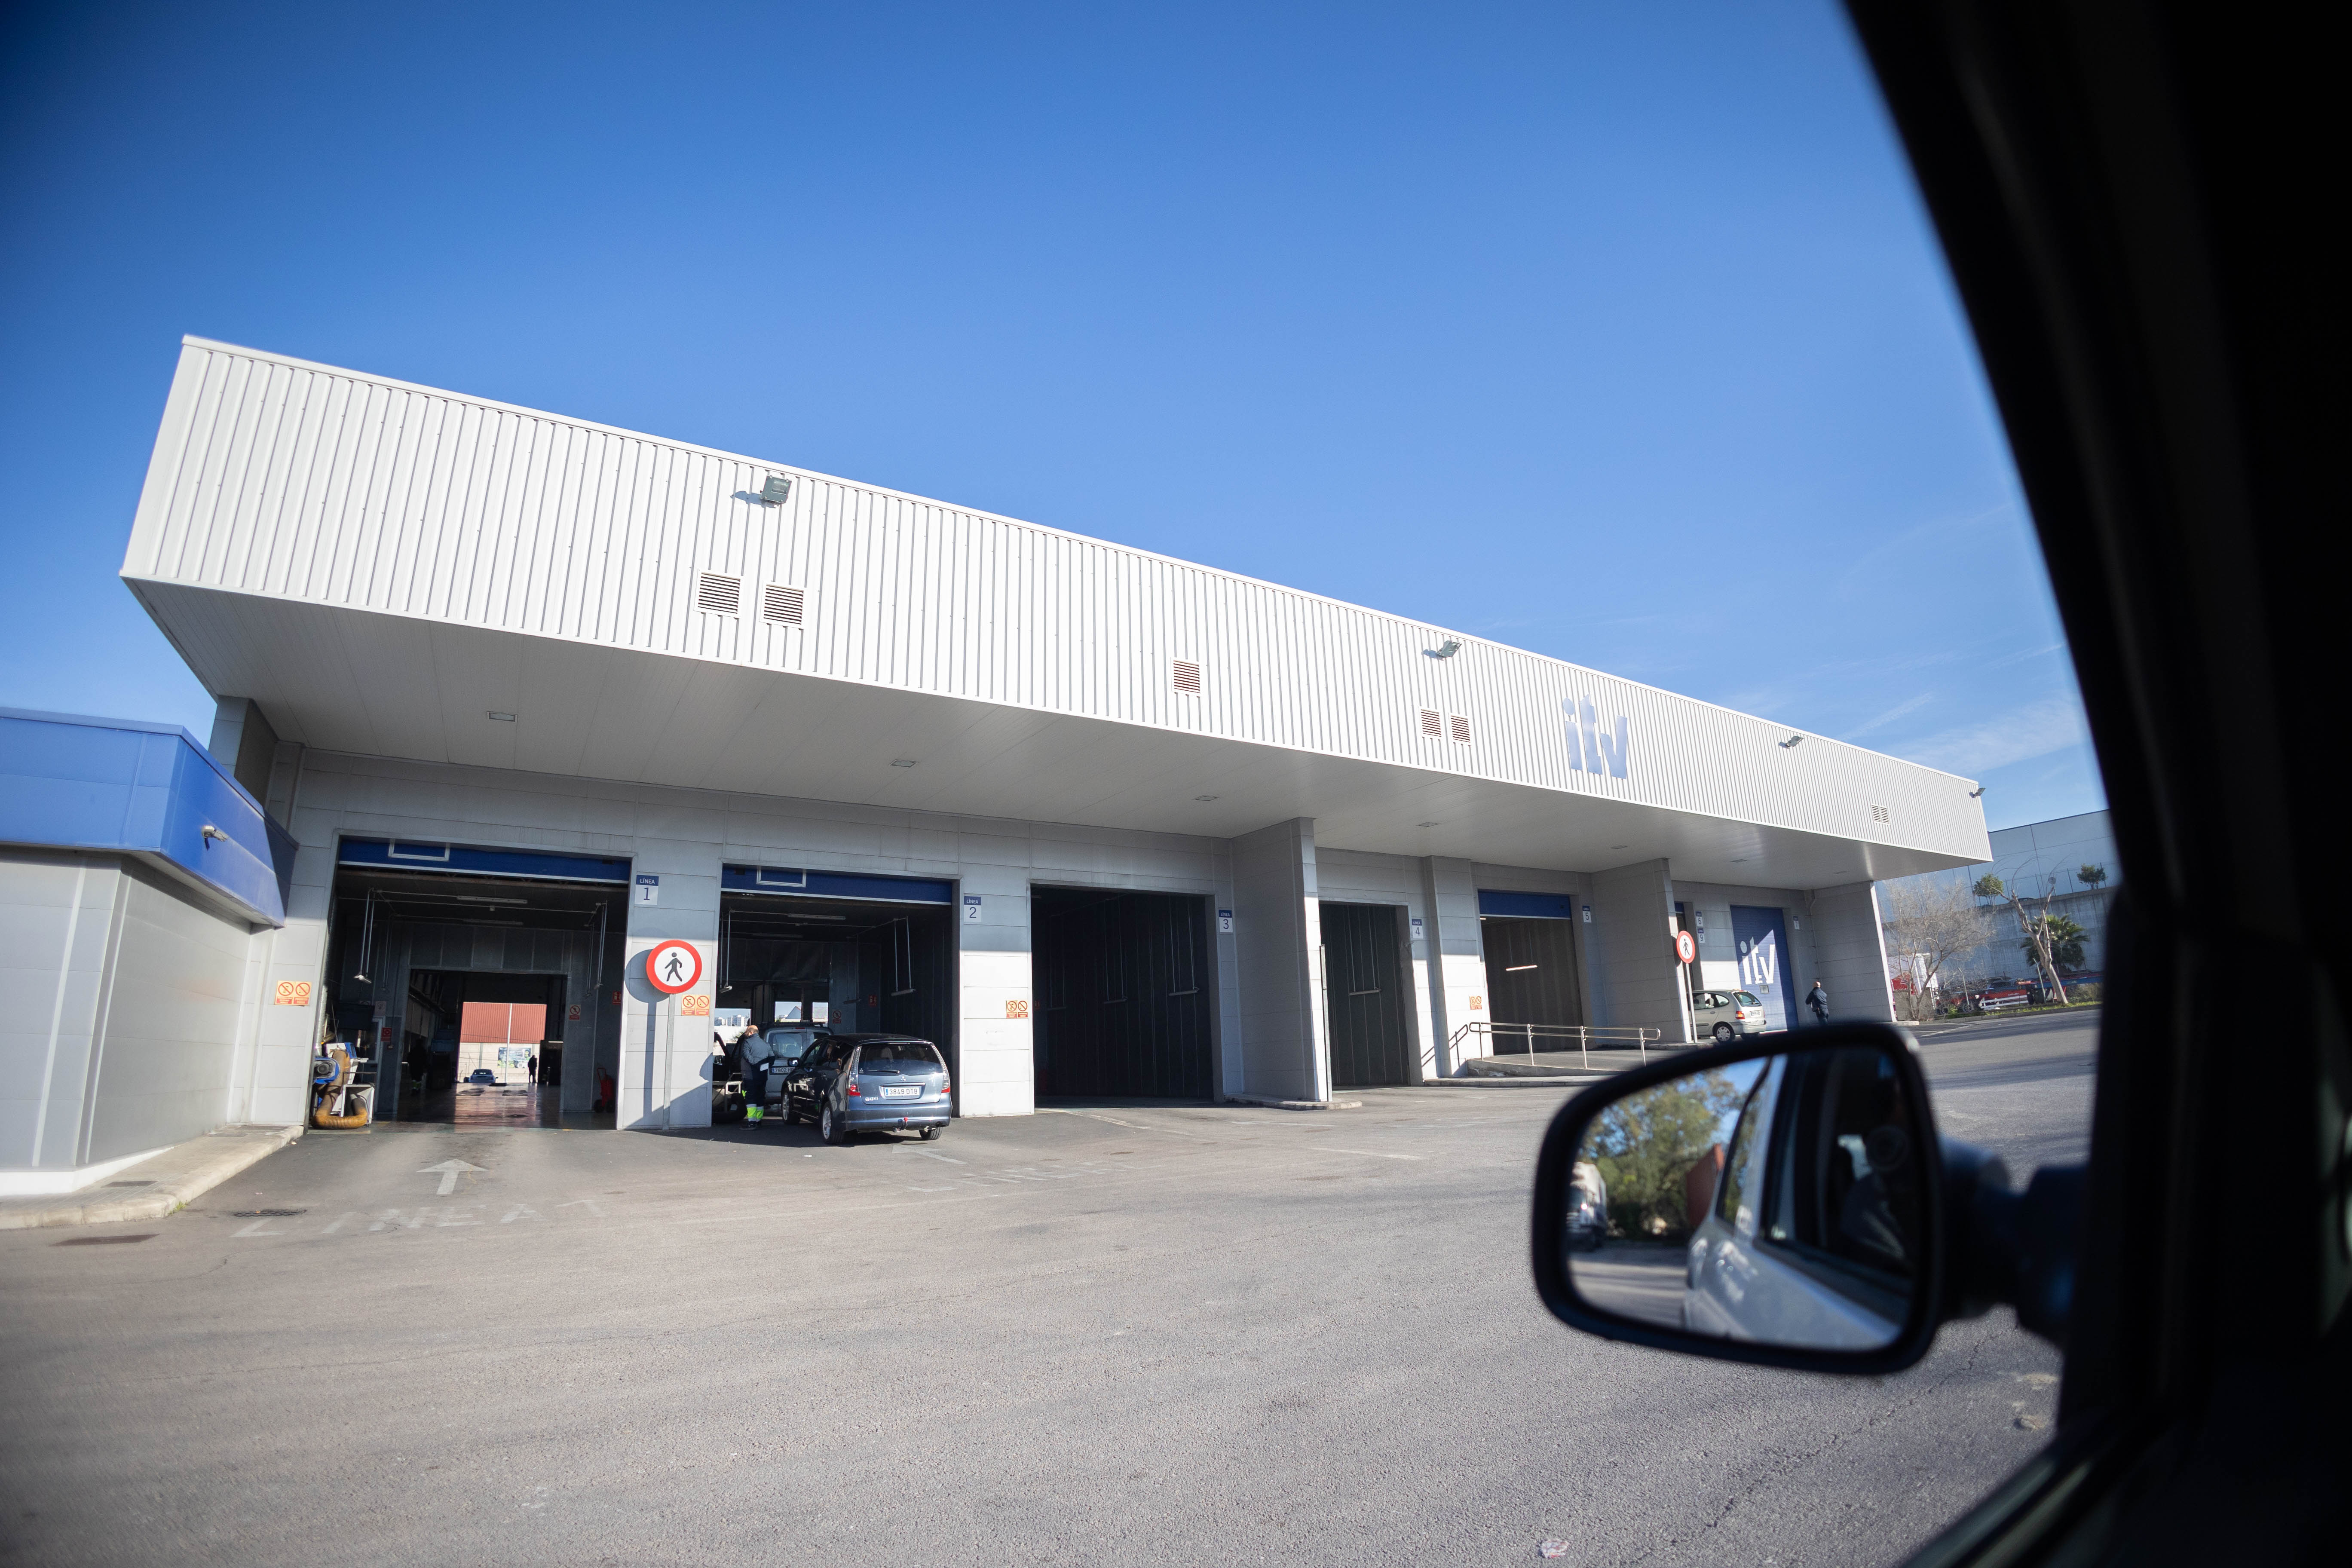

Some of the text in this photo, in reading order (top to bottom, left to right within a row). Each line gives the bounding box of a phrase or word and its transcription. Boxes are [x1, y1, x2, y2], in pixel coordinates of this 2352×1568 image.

[1562, 692, 1627, 779] itv
[643, 887, 650, 900] 1
[969, 906, 977, 918] 2
[1585, 912, 1589, 920] 5
[1223, 919, 1229, 929] 3
[1415, 927, 1420, 936] 4
[1740, 936, 1775, 985] itv
